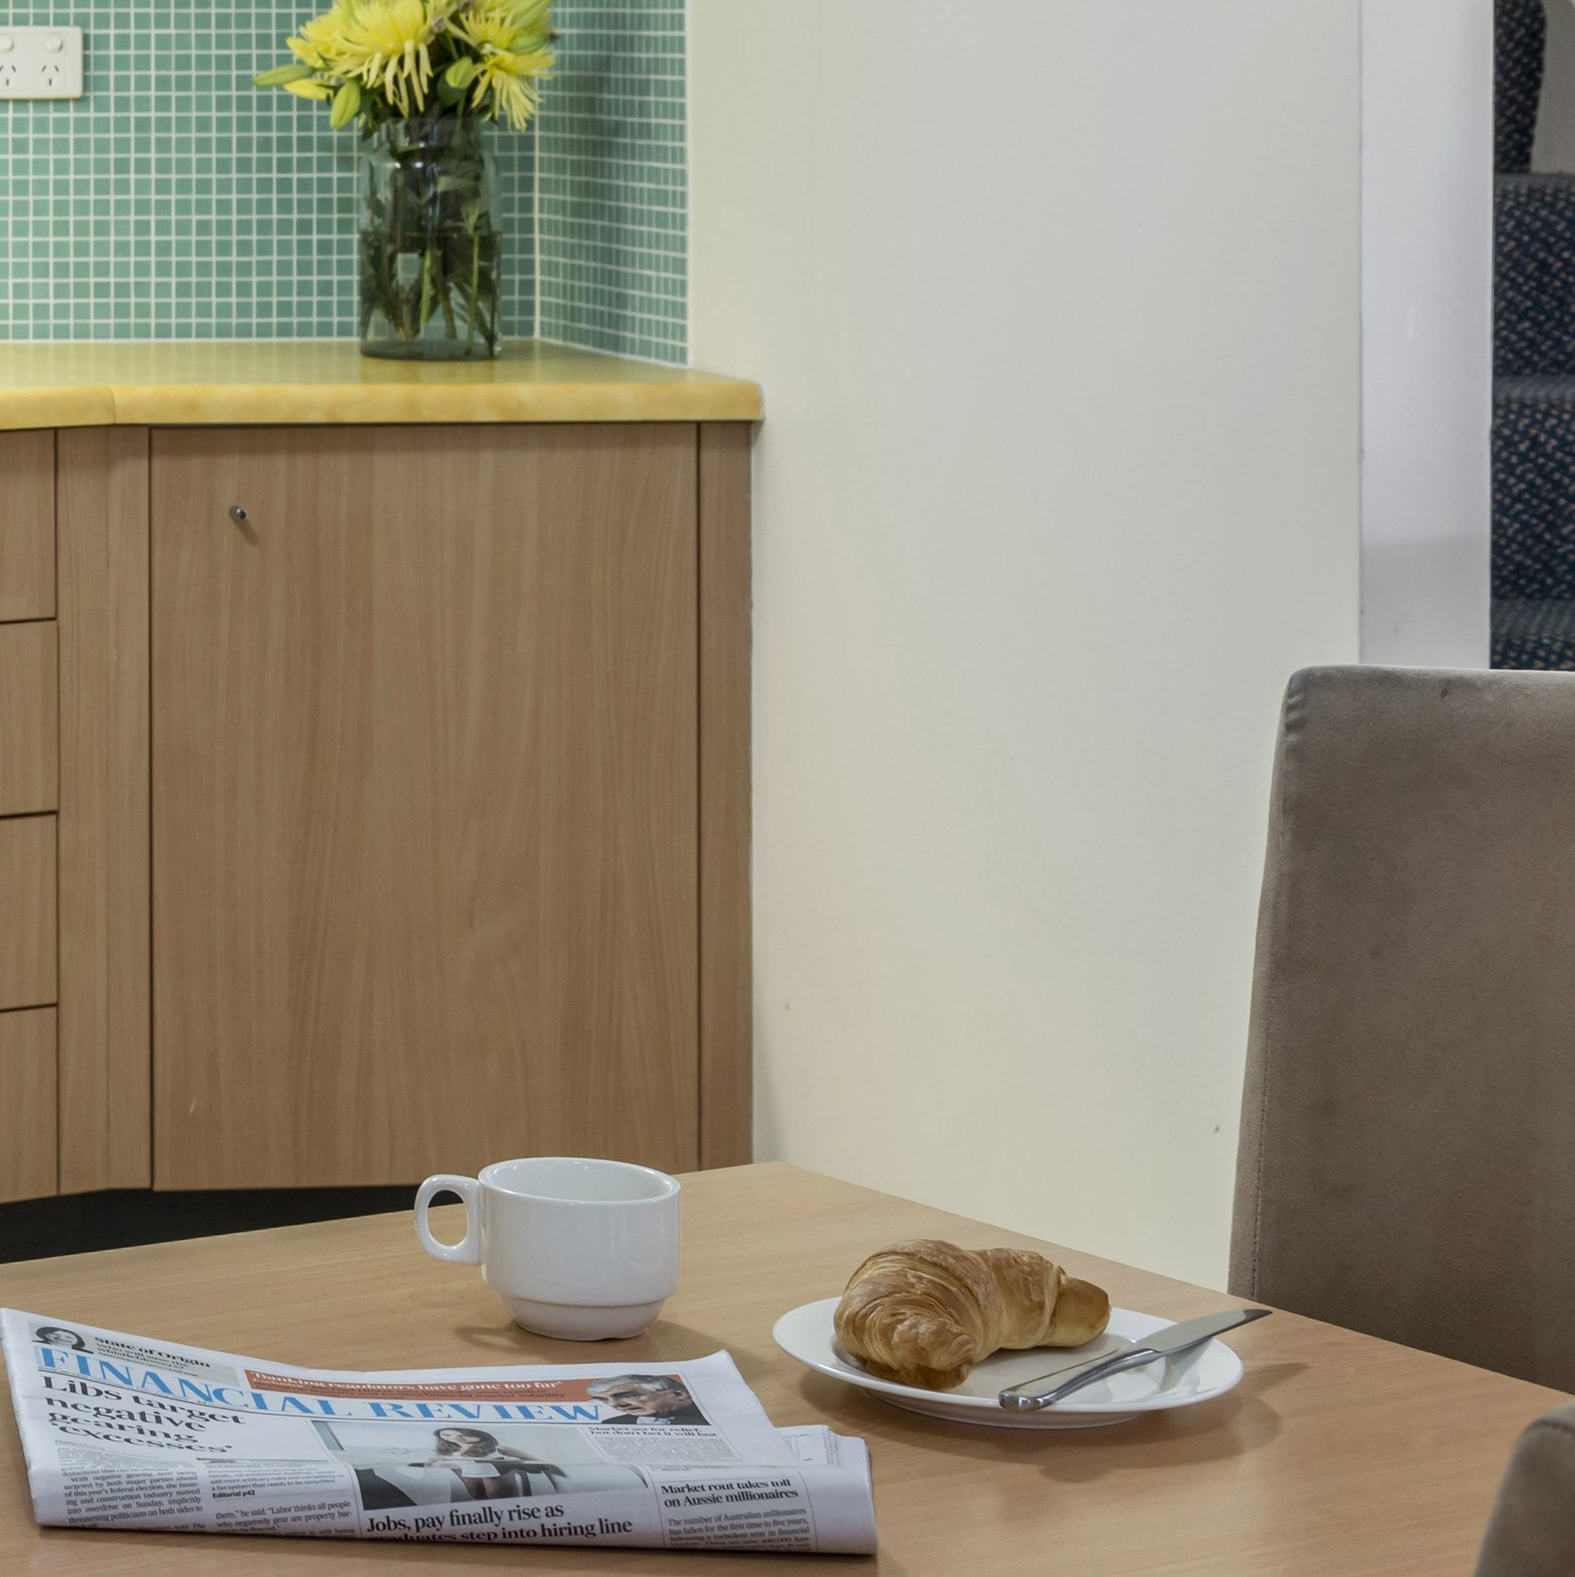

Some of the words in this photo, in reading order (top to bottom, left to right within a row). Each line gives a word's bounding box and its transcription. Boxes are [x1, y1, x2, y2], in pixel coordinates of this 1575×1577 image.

[95, 1336, 136, 1351] State
[157, 1352, 211, 1369] Origin
[38, 1347, 351, 1417] FINANCIAL
[368, 1402, 600, 1422] REVIEW
[459, 1384, 500, 1392] gone
[43, 1376, 122, 1401] Libs
[133, 1394, 246, 1425] target
[44, 1396, 207, 1433] negative
[47, 1412, 198, 1444] gearing
[51, 1423, 233, 1453] 'excesses'
[63, 1482, 93, 1491] targeted
[149, 1477, 174, 1485] parties
[93, 1474, 123, 1482] negative
[127, 1472, 153, 1480] gearing
[65, 1490, 73, 1498] of
[88, 1488, 109, 1497] year's
[109, 1486, 135, 1494] federal
[97, 1494, 142, 1503] construction
[143, 1490, 173, 1499] industry
[176, 1488, 201, 1496] moved
[211, 1490, 242, 1499] Editorial
[242, 1488, 256, 1498] p42
[661, 1482, 706, 1495] Market
[708, 1482, 735, 1492] rout
[737, 1480, 769, 1490] takes
[771, 1478, 792, 1488] toll
[67, 1507, 82, 1515] into
[85, 1504, 119, 1513] overdrive
[167, 1496, 202, 1507] implicitly
[664, 1498, 682, 1509] on
[683, 1492, 724, 1507] Aussie
[725, 1489, 799, 1504] millionaires
[68, 1513, 110, 1524] threatening
[110, 1510, 147, 1522] politicians
[159, 1507, 176, 1515] both
[177, 1506, 195, 1514] sides
[240, 1510, 249, 1518] he
[293, 1504, 317, 1513] thinks
[317, 1502, 327, 1510] all
[327, 1500, 351, 1511] people
[667, 1518, 682, 1527] The
[683, 1516, 712, 1525] number
[714, 1514, 722, 1522] of
[723, 1512, 761, 1522] Australian
[763, 1508, 807, 1519] millionaires
[217, 1520, 234, 1528] who
[235, 1518, 270, 1528] negatively
[273, 1516, 288, 1526] gear
[305, 1512, 336, 1523] property
[367, 1516, 412, 1533] Jobs,
[415, 1515, 446, 1532] pay
[449, 1506, 504, 1527] finally
[507, 1505, 541, 1521] rise
[545, 1504, 564, 1517] as
[669, 1528, 683, 1536] has
[683, 1526, 704, 1535] fallen
[705, 1524, 715, 1533] for
[717, 1523, 729, 1532] the
[730, 1522, 745, 1531] first
[746, 1521, 763, 1530] time
[765, 1520, 772, 1528] in
[773, 1518, 786, 1527] five
[461, 1530, 498, 1542] step
[501, 1527, 538, 1540] into
[541, 1521, 597, 1539] hiring
[600, 1518, 633, 1535] line
[713, 1532, 748, 1540] turbulent
[778, 1526, 810, 1536] financial
